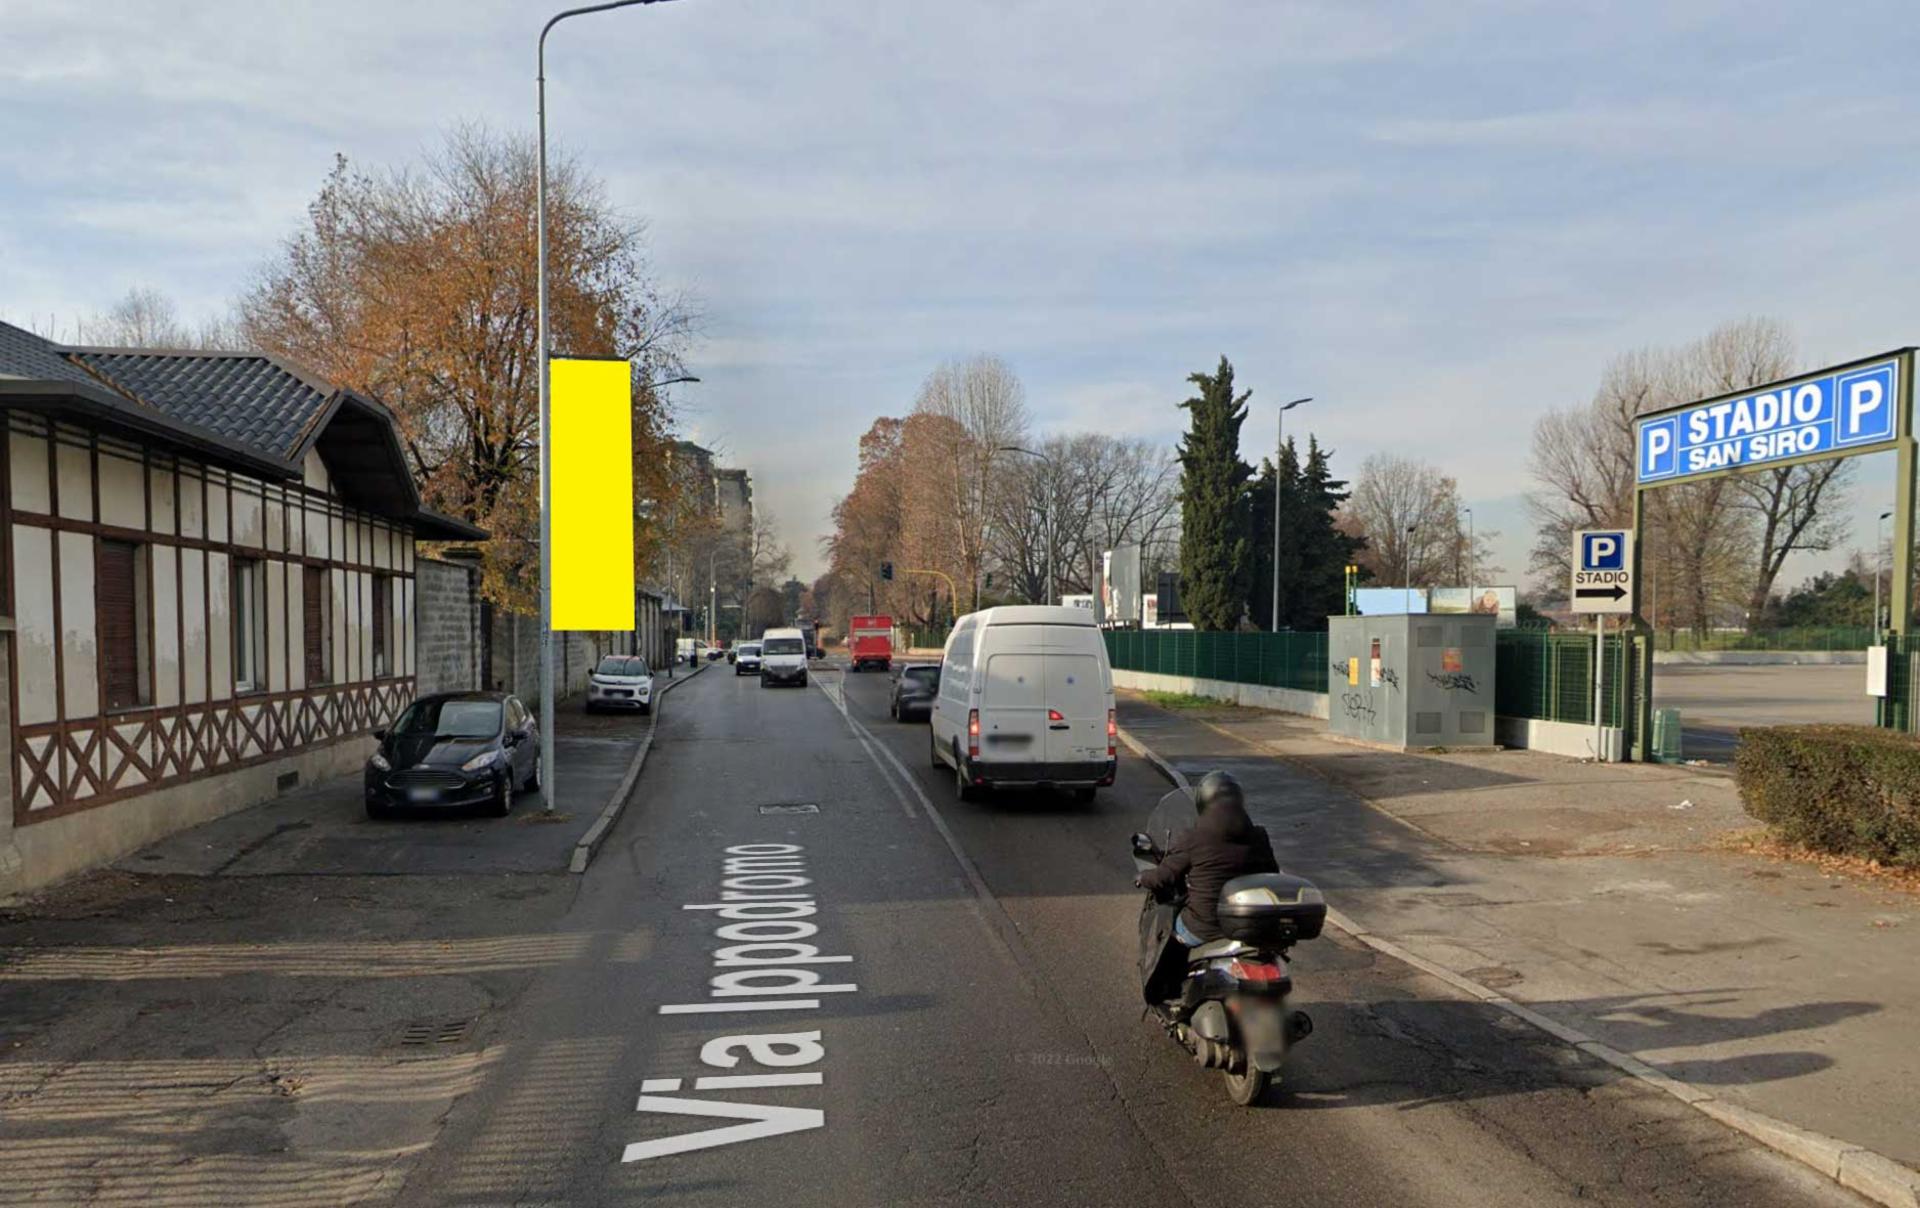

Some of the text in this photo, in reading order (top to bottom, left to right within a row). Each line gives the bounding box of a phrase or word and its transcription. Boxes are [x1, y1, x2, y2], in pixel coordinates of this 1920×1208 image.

[1688, 383, 1822, 444] STADIO
[1850, 380, 1883, 433] P
[1648, 428, 1671, 471] P
[1689, 426, 1820, 471] SAN SIRO
[1591, 537, 1616, 567] P
[1576, 572, 1629, 584] STADIO
